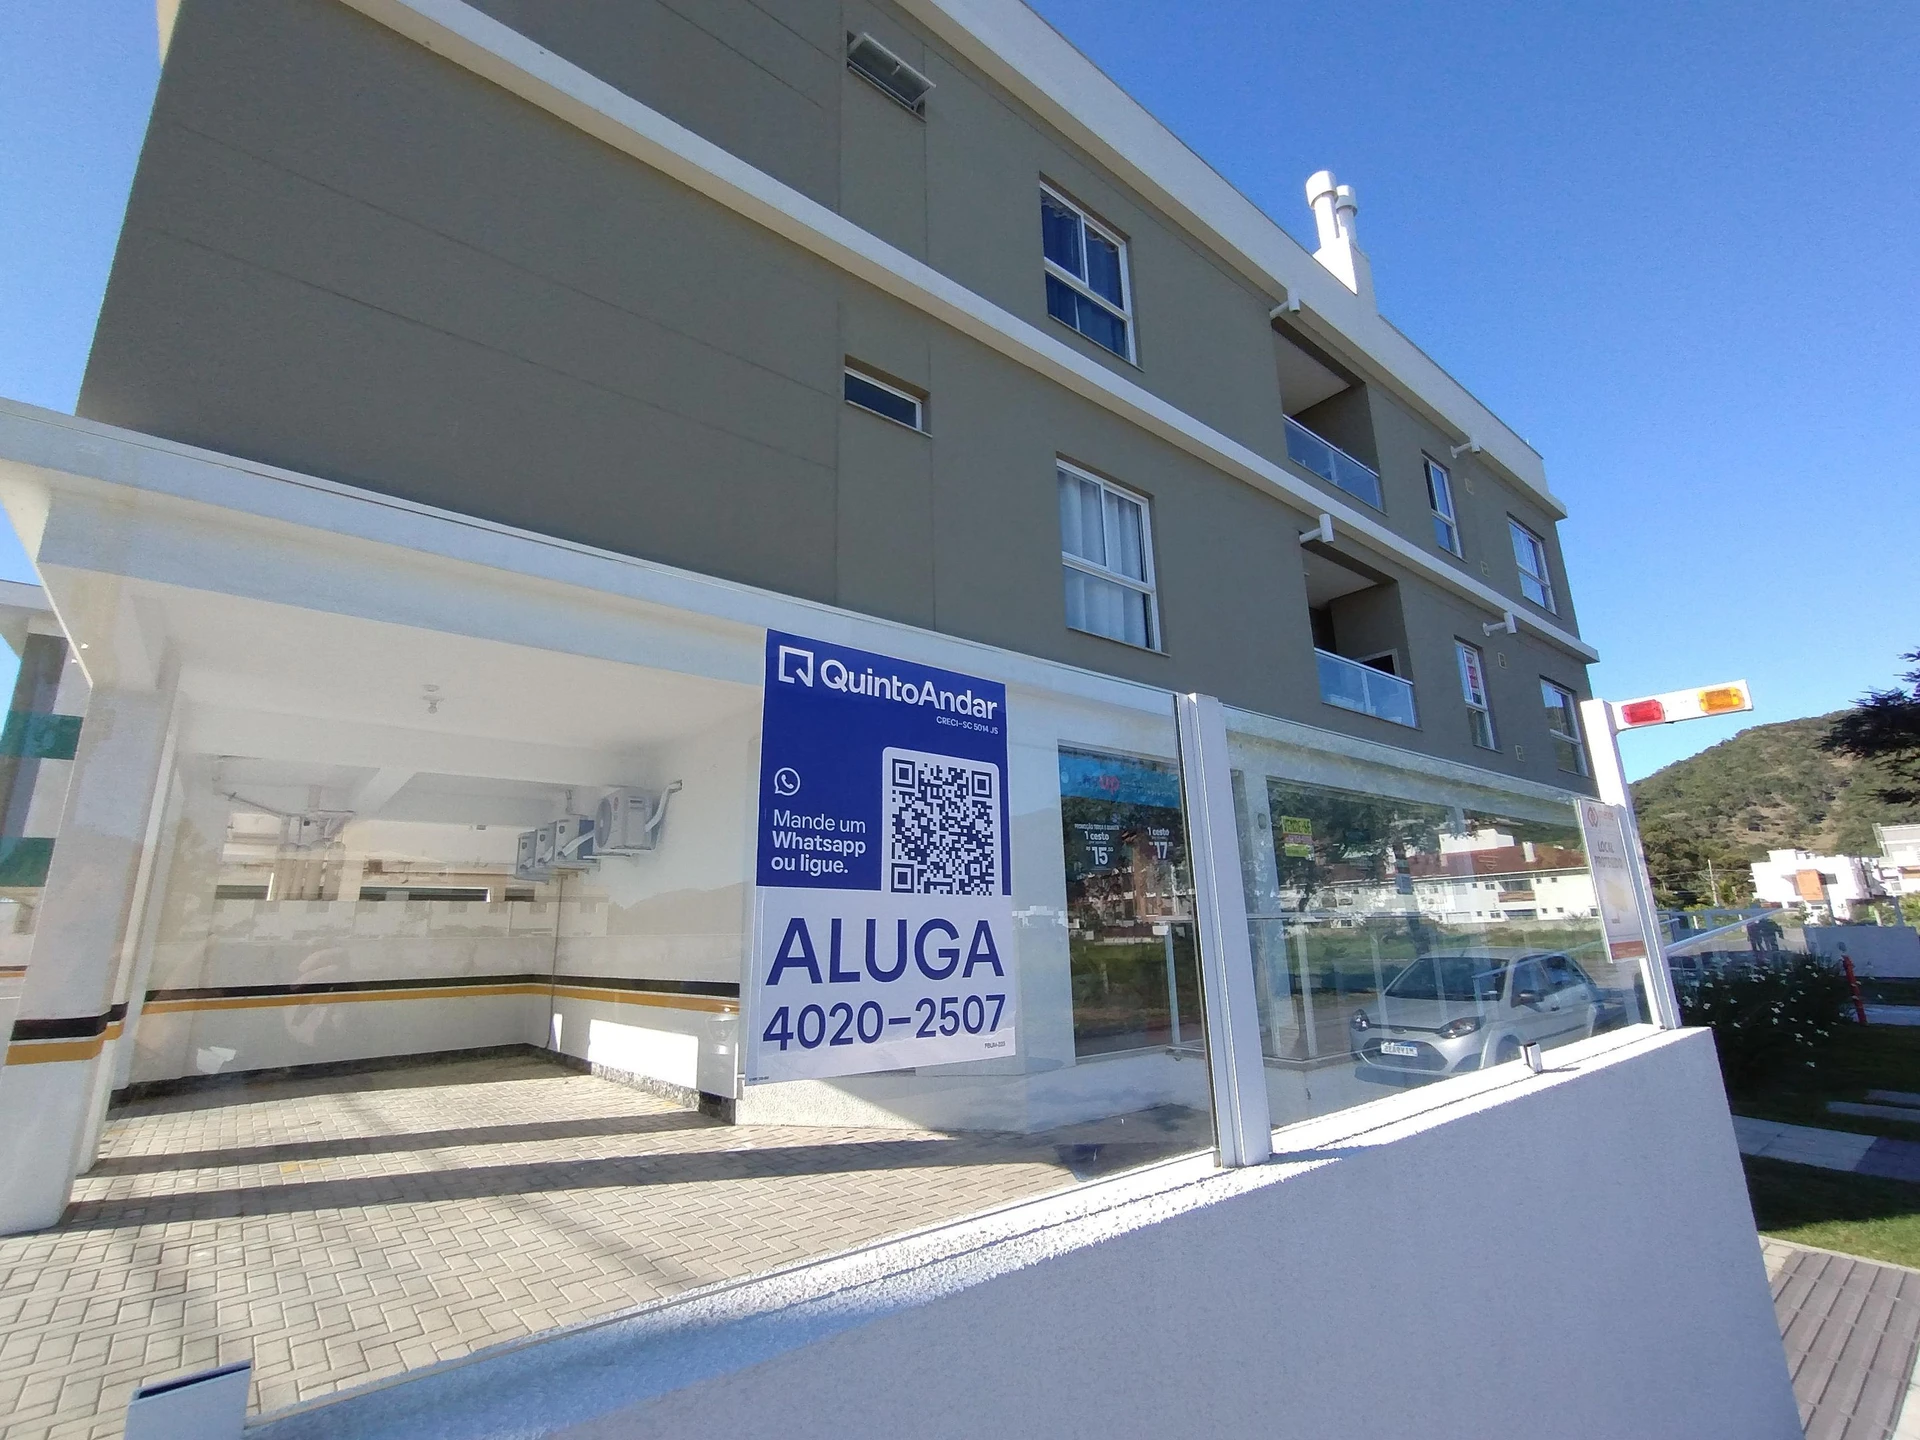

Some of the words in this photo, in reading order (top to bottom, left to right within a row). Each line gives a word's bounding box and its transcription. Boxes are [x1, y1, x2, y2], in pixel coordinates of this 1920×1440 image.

[820, 659, 998, 720] QuintoAndar
[936, 716, 973, 729] CRECI-SC
[973, 723, 989, 733] 5014
[990, 727, 999, 735] JS
[773, 808, 836, 831] Mande
[839, 817, 866, 833] um
[1152, 828, 1170, 836] cesto
[772, 830, 866, 857] Whatsapp
[1090, 832, 1110, 841] cesto
[771, 856, 796, 871] ou
[800, 853, 849, 877] ligue.
[765, 917, 1005, 986] ALUGA
[762, 994, 1006, 1051] 4020-2507
